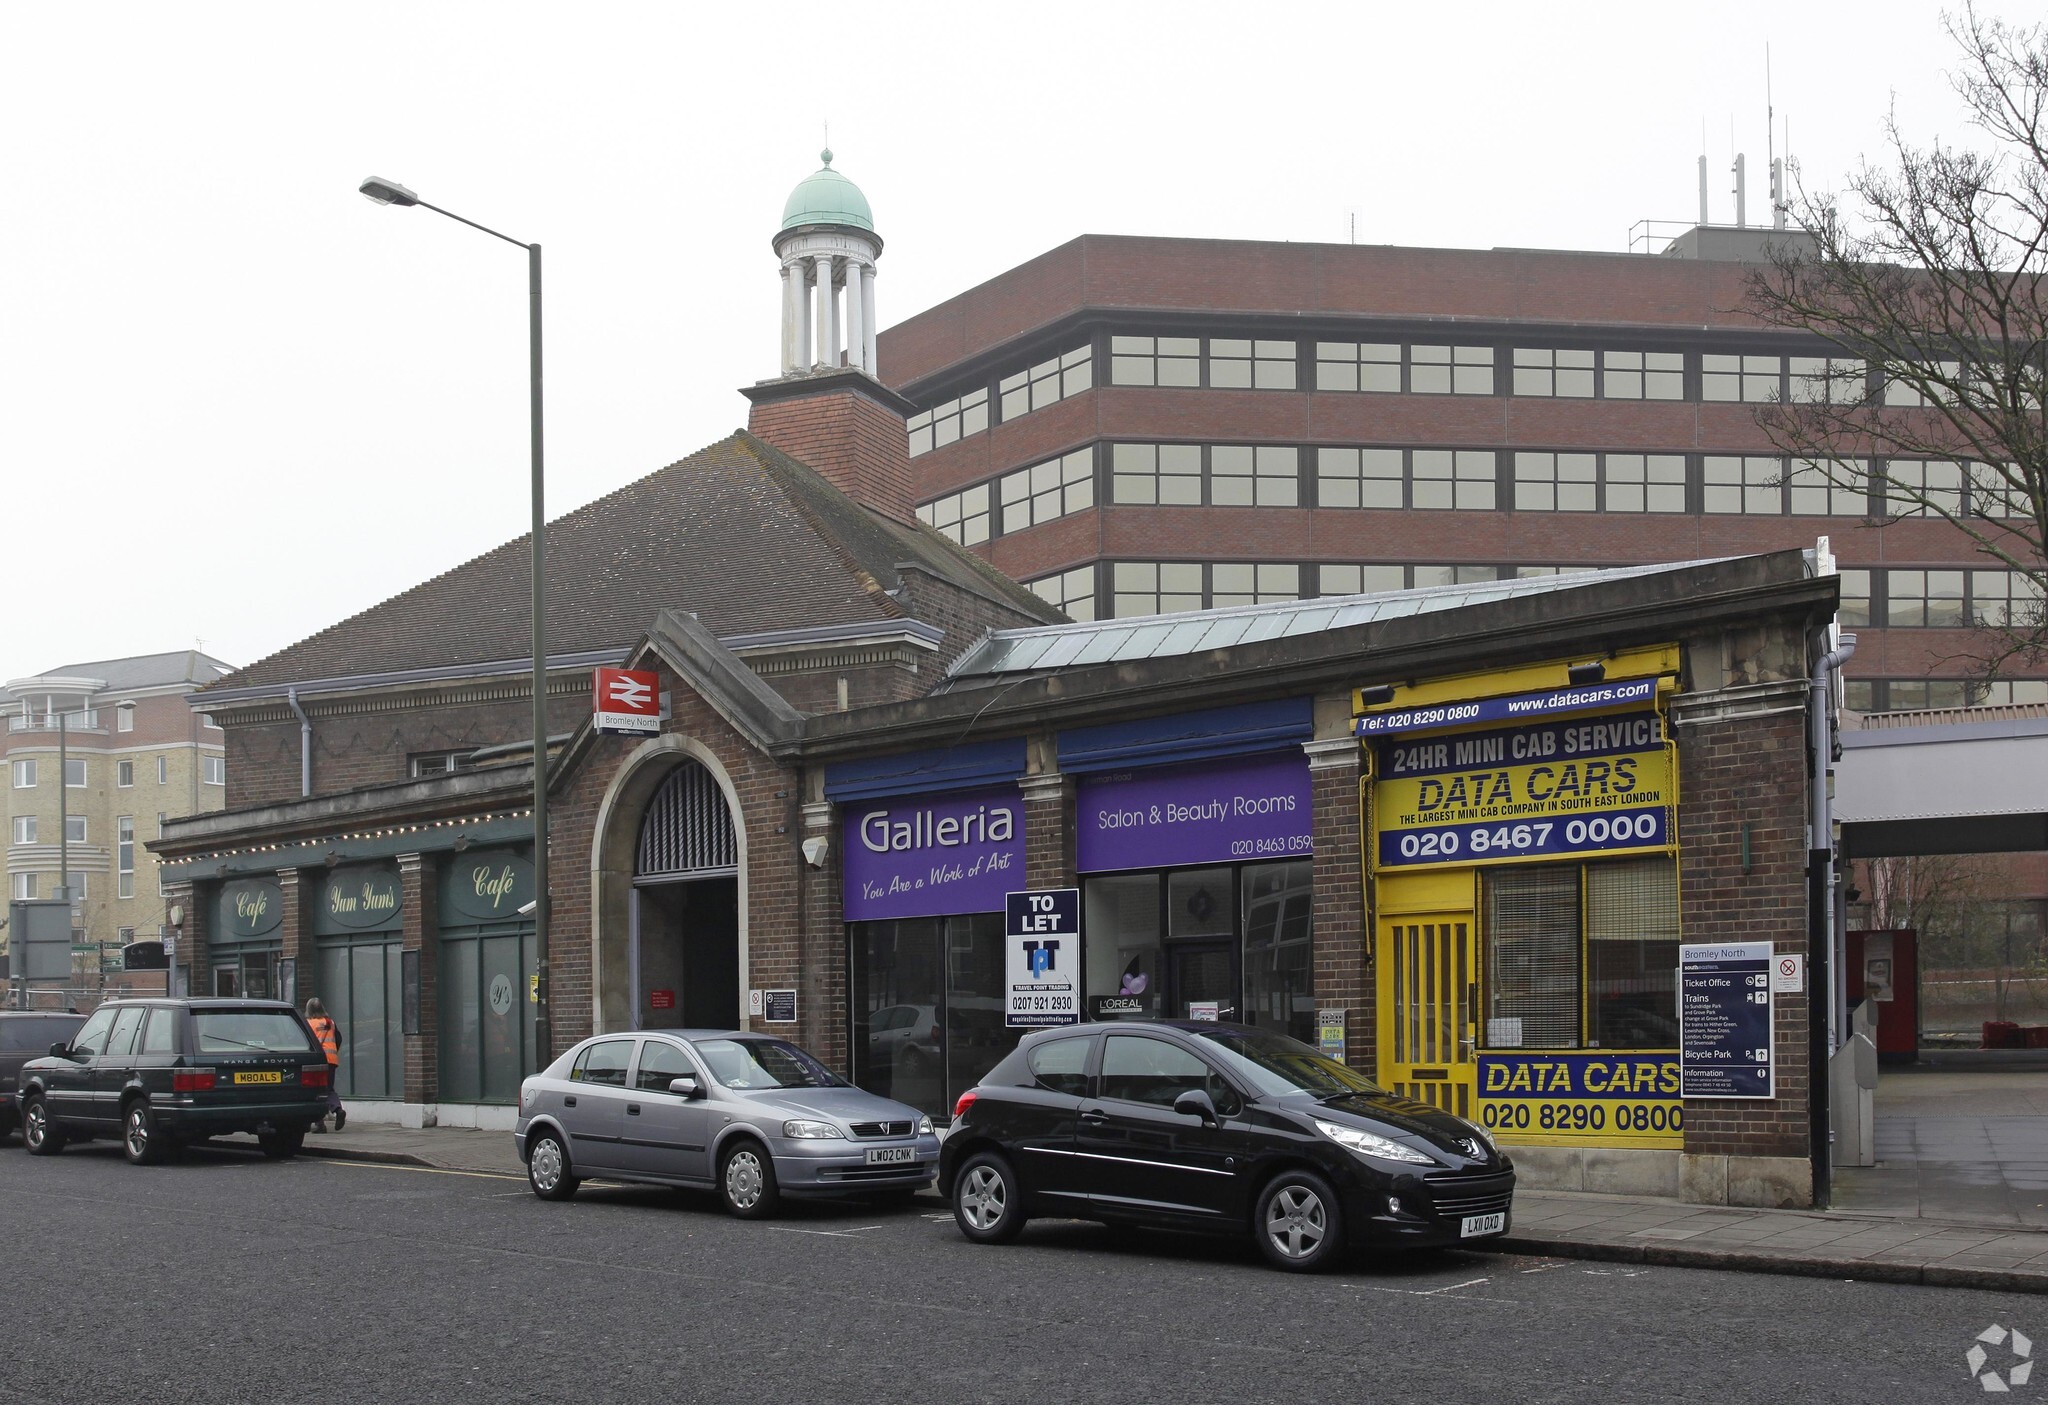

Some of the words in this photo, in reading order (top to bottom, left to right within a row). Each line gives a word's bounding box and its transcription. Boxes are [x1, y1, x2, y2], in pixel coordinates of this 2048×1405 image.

[1508, 683, 1649, 712] www.datacars.com
[606, 715, 636, 727] Bromley
[637, 718, 658, 727] North
[1361, 717, 1385, 730] Tel:
[1387, 714, 1411, 728] 020
[1413, 709, 1445, 725] 8290
[1447, 704, 1480, 720] 0800
[1393, 744, 1448, 773] 24HR
[1455, 737, 1504, 766] MINI
[1512, 731, 1557, 760] CAB
[1564, 718, 1664, 754] SERVICE
[1417, 771, 1513, 812] DATA
[1526, 757, 1638, 802] CARS
[1098, 808, 1144, 829] Salon
[1149, 805, 1162, 825] &
[1167, 799, 1229, 823] Beauty
[1233, 795, 1296, 816] Rooms
[1400, 814, 1416, 825] THE
[1418, 810, 1455, 823] LARGEST
[1457, 808, 1478, 820] MINI
[1480, 806, 1498, 818] CAB
[1501, 802, 1545, 817] COMPANY
[1548, 801, 1558, 811] IN
[1561, 797, 1592, 810] SOUTH
[1594, 795, 1618, 807] EAST
[1621, 791, 1660, 804] LONDON
[860, 805, 1013, 852] Galleria
[1400, 831, 1459, 858] 020
[1469, 822, 1554, 853] 8467
[1565, 813, 1657, 845] 0000
[1231, 840, 1254, 855] 020
[1256, 837, 1285, 853] 8463
[473, 865, 515, 908] Café
[863, 880, 885, 900] You
[888, 875, 912, 896] Are
[915, 878, 924, 889] a
[930, 864, 964, 885] Work
[968, 856, 984, 878] of
[986, 852, 1013, 873] Art
[236, 890, 268, 927] Café
[331, 885, 357, 914] Yum
[362, 882, 394, 911] Yum's
[1028, 895, 1055, 912] TO
[1022, 914, 1062, 932] LET
[1685, 950, 1719, 960] Bromley
[1721, 949, 1746, 958] North
[1684, 979, 1707, 987] Ticket
[1708, 978, 1731, 987] Office
[1013, 997, 1032, 1010] 0207
[1035, 997, 1049, 1010] 921
[1052, 996, 1072, 1010] 2930
[1684, 993, 1709, 1002] Trains
[1685, 1050, 1712, 1060] Bicycle
[1714, 1050, 1732, 1058] Park
[1485, 1063, 1572, 1092] DATA
[1583, 1062, 1680, 1093] CARS
[1684, 1069, 1724, 1077] Information
[1483, 1103, 1530, 1129] 020
[1539, 1103, 1605, 1130] 8290
[1615, 1104, 1684, 1132] 0800
[870, 1150, 894, 1162] LW02
[896, 1148, 912, 1160] CNK
